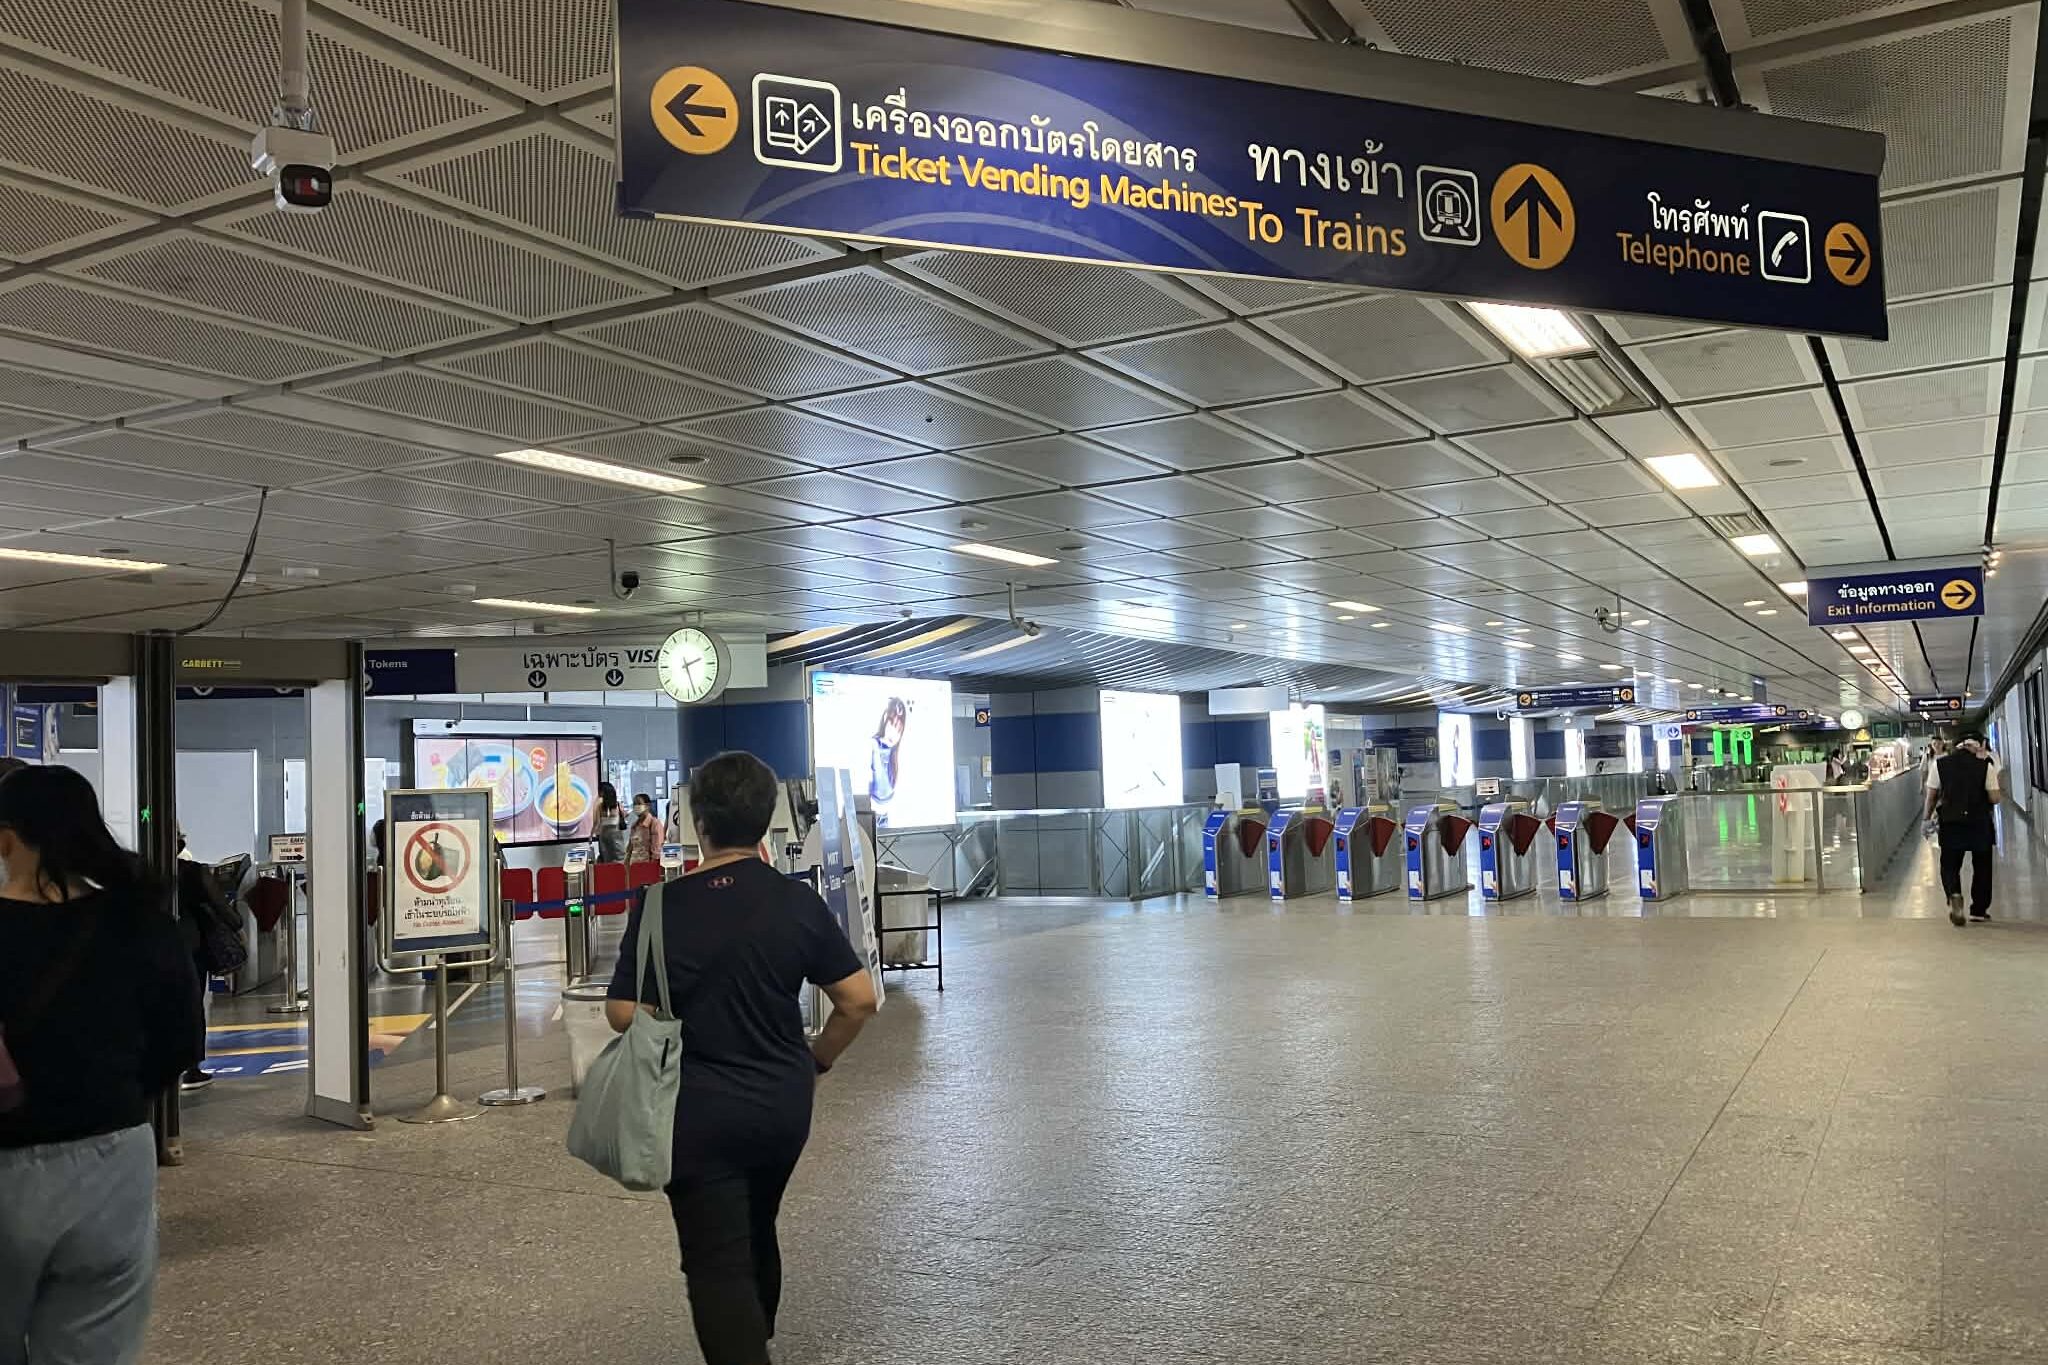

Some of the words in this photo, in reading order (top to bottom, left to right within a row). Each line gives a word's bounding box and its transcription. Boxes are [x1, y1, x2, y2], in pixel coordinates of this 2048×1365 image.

[851, 87, 1197, 172] เครื่องออกบัตรโดยสาร
[850, 141, 952, 187] Ticket
[964, 153, 1091, 210] Vending
[1099, 174, 1238, 219] Machines
[1247, 138, 1405, 200] ทางเข้า
[1239, 201, 1284, 245] To
[1295, 206, 1408, 258] Trains
[1646, 192, 1750, 241] โทรศัพท์
[1616, 232, 1751, 277] Telephone
[1827, 604, 1852, 617] Exit
[1855, 599, 1936, 615] Information
[1838, 581, 1935, 601] ข้อมูลทางออก
[368, 658, 408, 669] Tokens
[522, 645, 620, 669] เฉพาะบัตร
